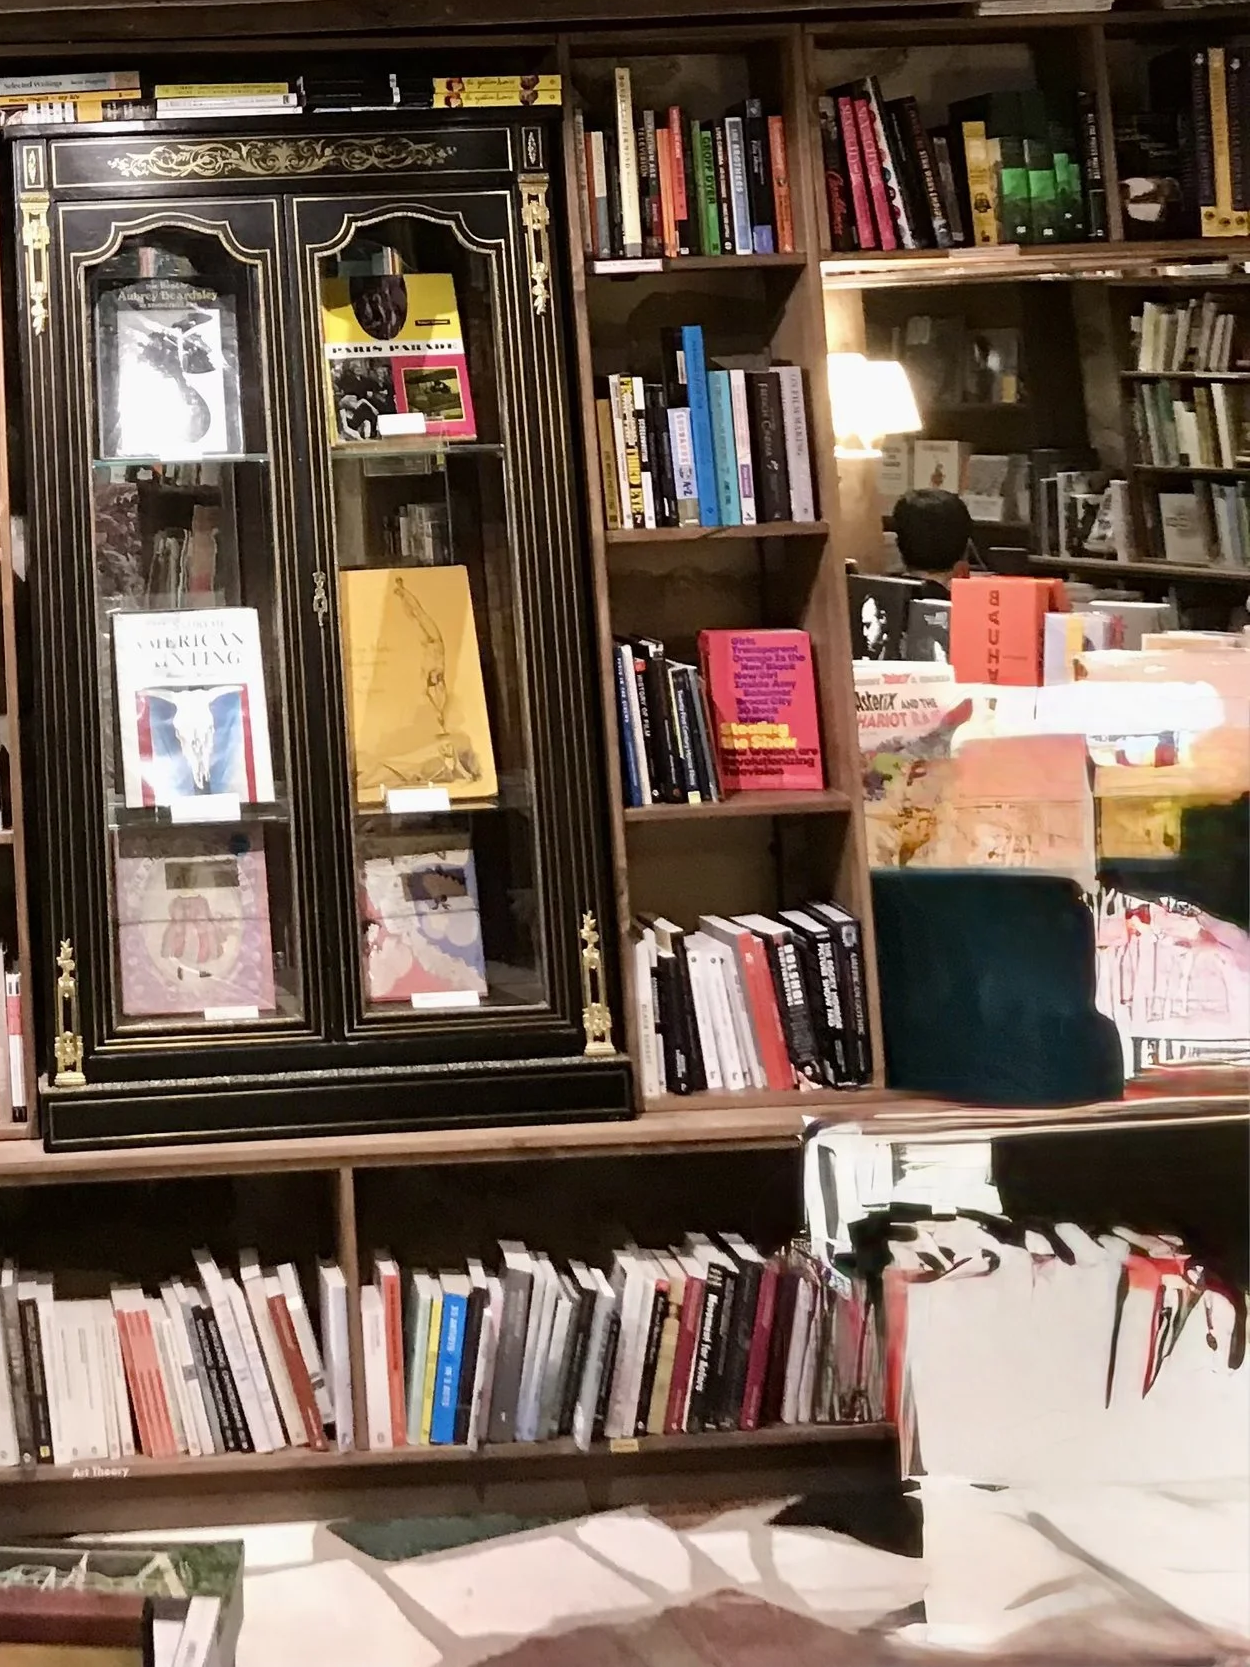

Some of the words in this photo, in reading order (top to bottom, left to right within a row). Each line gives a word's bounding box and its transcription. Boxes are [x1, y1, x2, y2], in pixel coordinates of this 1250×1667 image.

[637, 126, 647, 177] TELEVISION
[645, 125, 654, 161] PLATINUM
[701, 136, 712, 172] GEOFF
[704, 174, 715, 204] DYER
[117, 290, 159, 302] Aubrey
[159, 288, 218, 303] Beardsley
[332, 343, 382, 354] PARIS
[389, 342, 459, 352] PARADE
[625, 447, 641, 484] THIRD
[629, 487, 643, 513] EYE
[635, 674, 646, 705] HISTORY
[676, 689, 685, 711] Twenty
[855, 691, 898, 712] Asterix
[901, 698, 919, 709] AND
[919, 697, 938, 708] THE
[640, 706, 648, 717] OF
[857, 712, 908, 728] HARIOT
[642, 718, 651, 737] FILM
[681, 725, 690, 749] Century
[750, 734, 798, 750] Show
[684, 749, 693, 769] Horror
[687, 769, 696, 786] Films
[816, 942, 828, 977] PICTURE
[784, 942, 805, 1006] BOLSHOI
[825, 958, 837, 990] ROCKY
[849, 951, 862, 997] AMERICAN
[821, 978, 833, 1008] SHOW
[830, 991, 843, 1029] HORROR
[852, 999, 864, 1035] GOTHIC
[72, 1467, 90, 1478] Art
[92, 1465, 130, 1478] Theory
